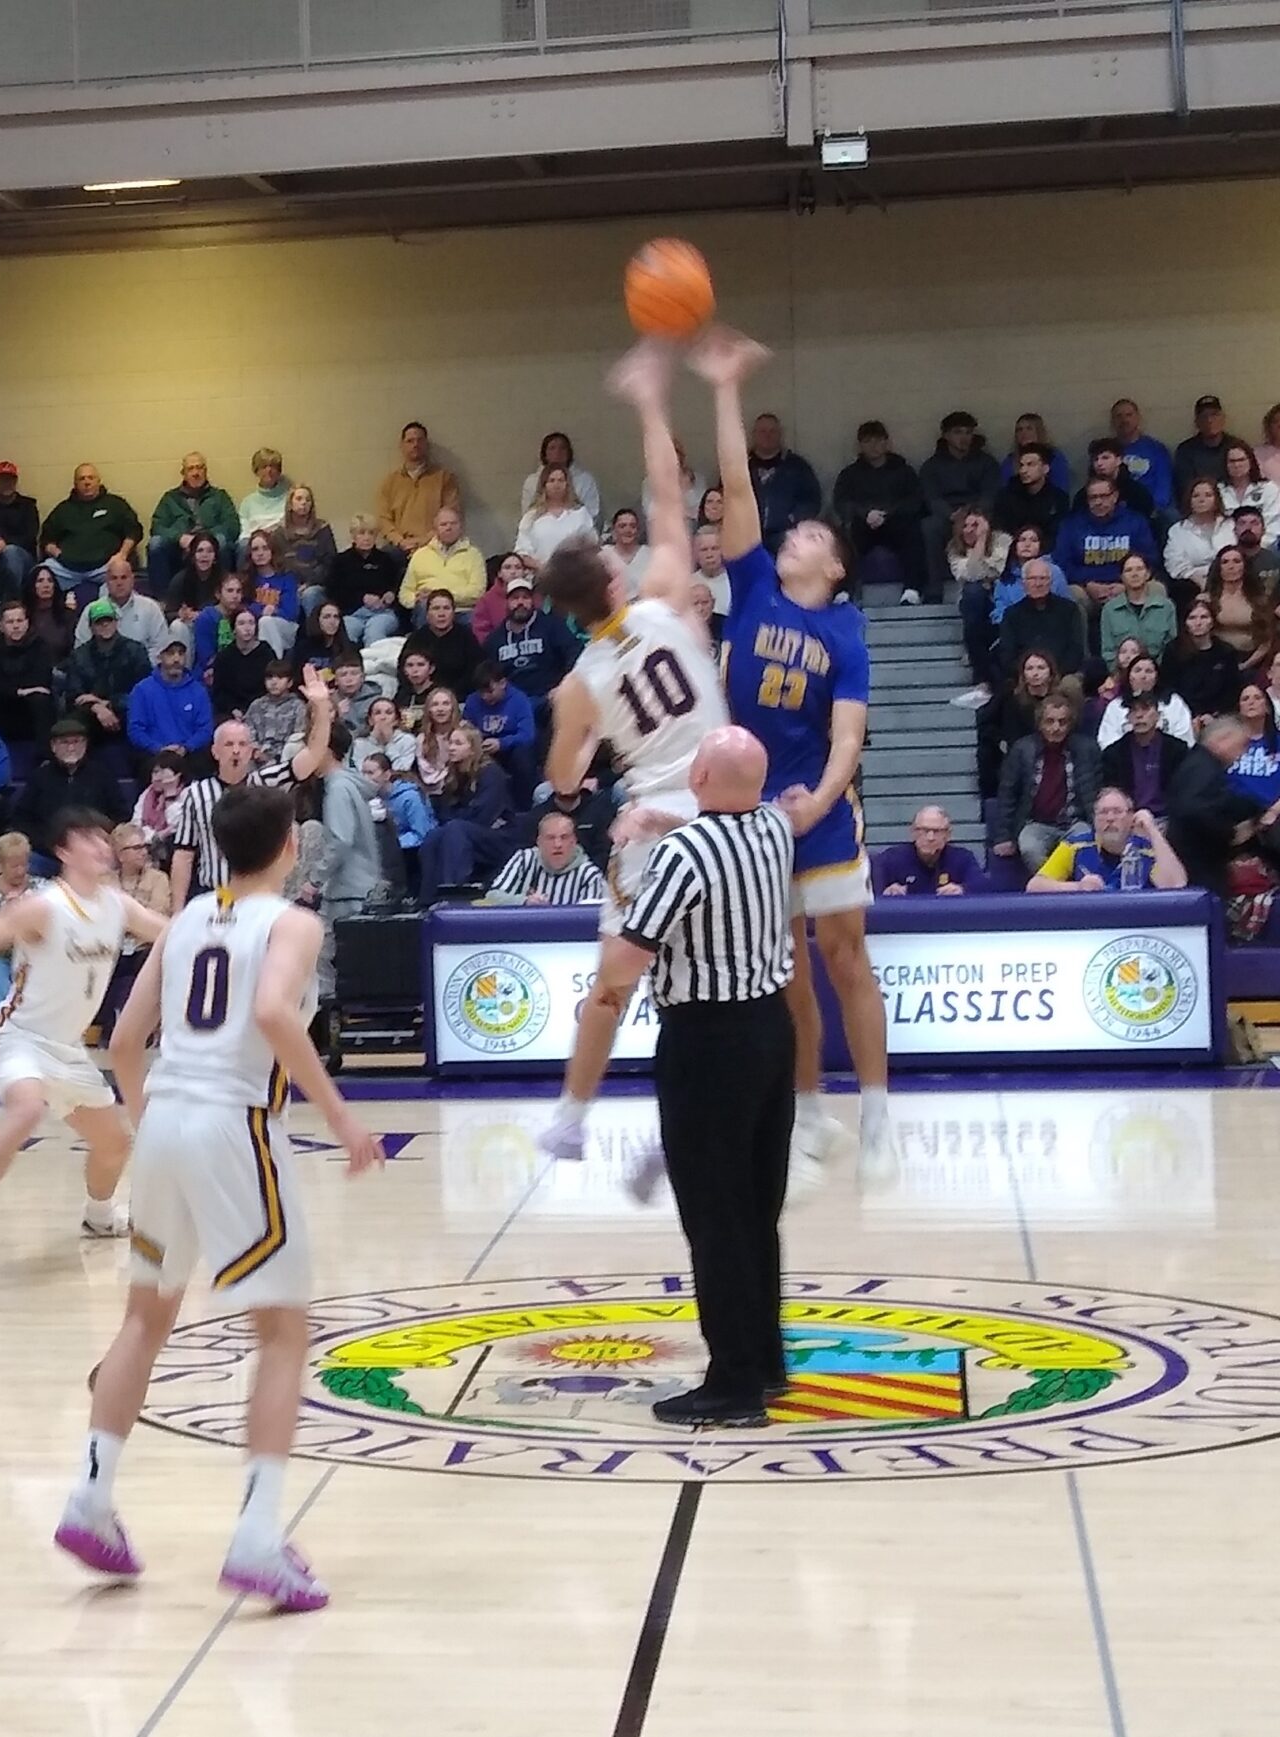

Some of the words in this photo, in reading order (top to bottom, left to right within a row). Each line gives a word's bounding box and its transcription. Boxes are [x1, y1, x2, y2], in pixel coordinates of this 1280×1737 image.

[619, 646, 695, 737] 10
[757, 662, 808, 711] 23
[186, 945, 230, 1030] 0
[871, 963, 984, 987] SCRANTON
[1001, 962, 1058, 983] PREP
[882, 988, 1055, 1025] LASSICS
